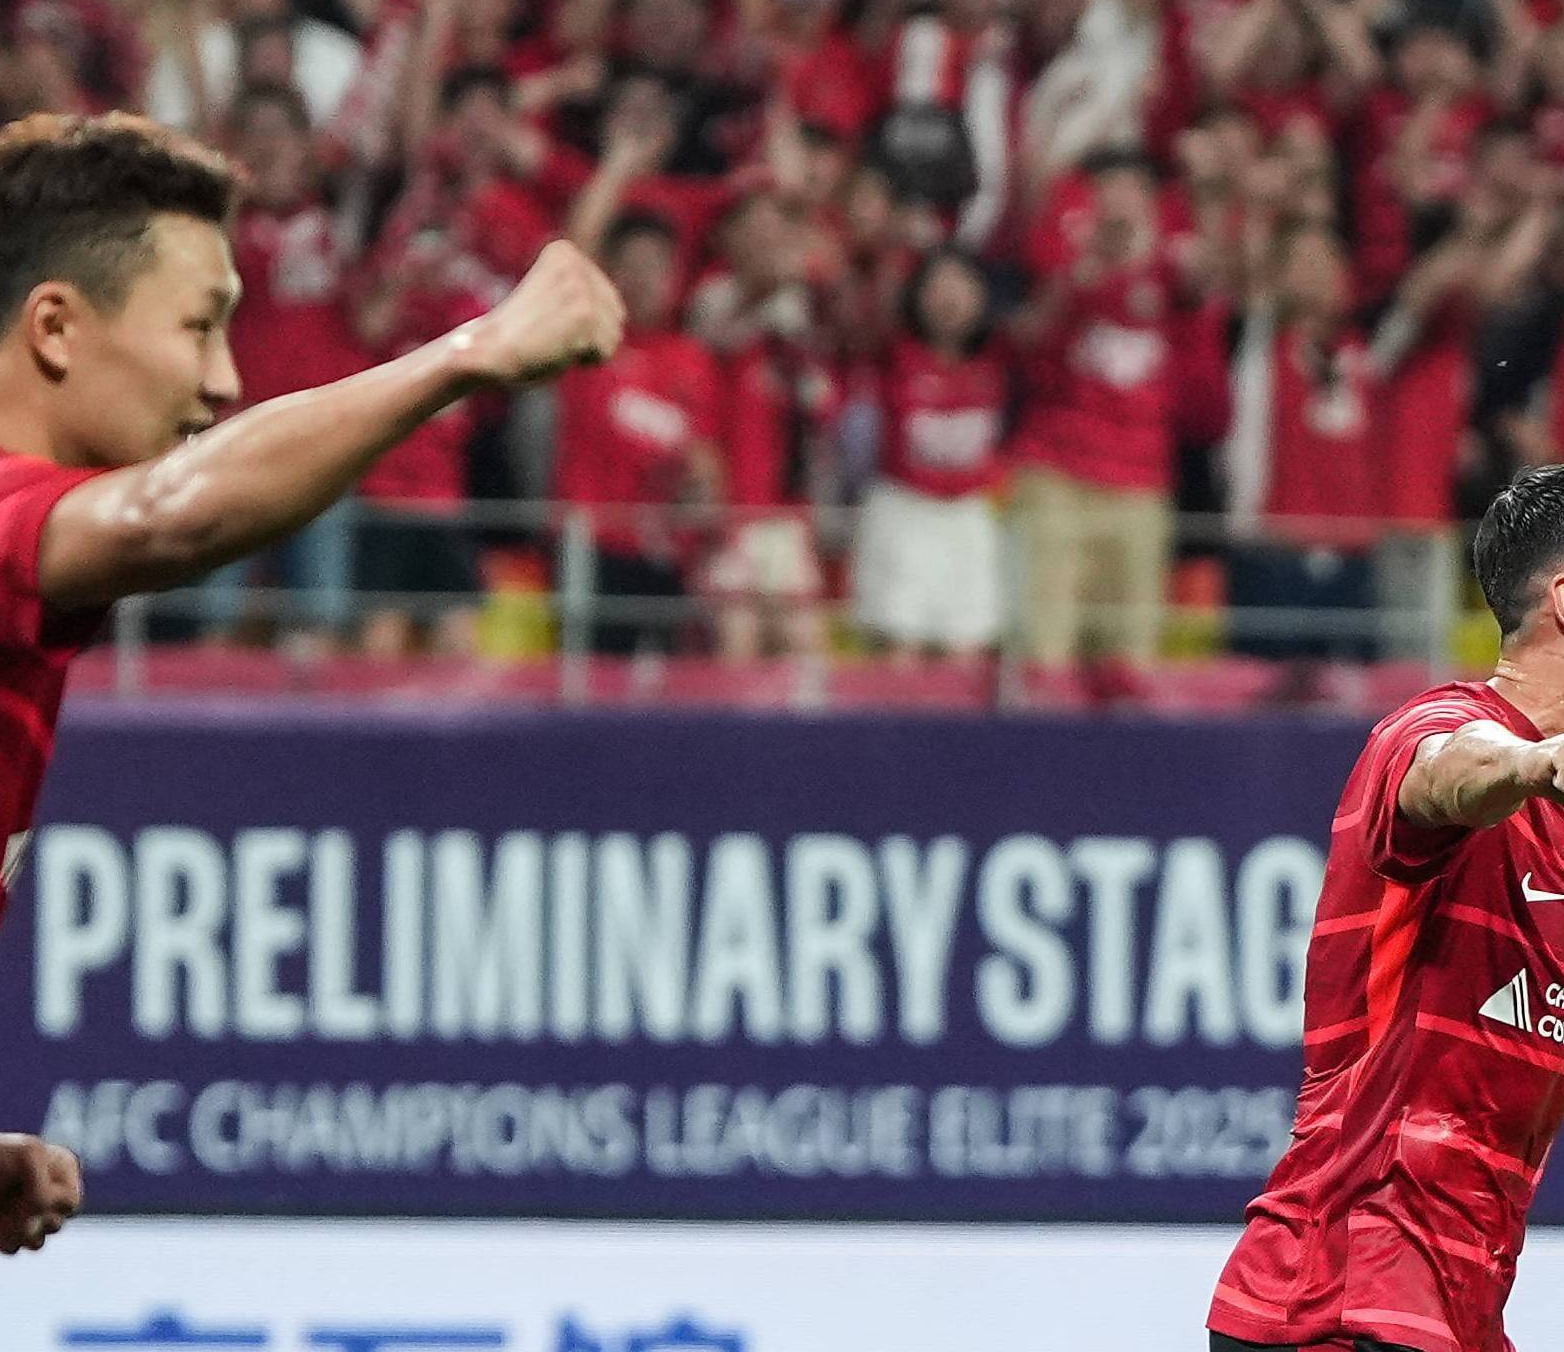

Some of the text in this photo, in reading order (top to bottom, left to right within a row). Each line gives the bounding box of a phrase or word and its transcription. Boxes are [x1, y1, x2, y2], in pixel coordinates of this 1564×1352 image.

[33, 823, 1326, 1048] PRELIMINARY STAG
[42, 1080, 182, 1174] AFC
[188, 1080, 641, 1176] CHAMPIONS
[643, 1082, 920, 1178] LEAGUE
[926, 1084, 1120, 1178] ELITE
